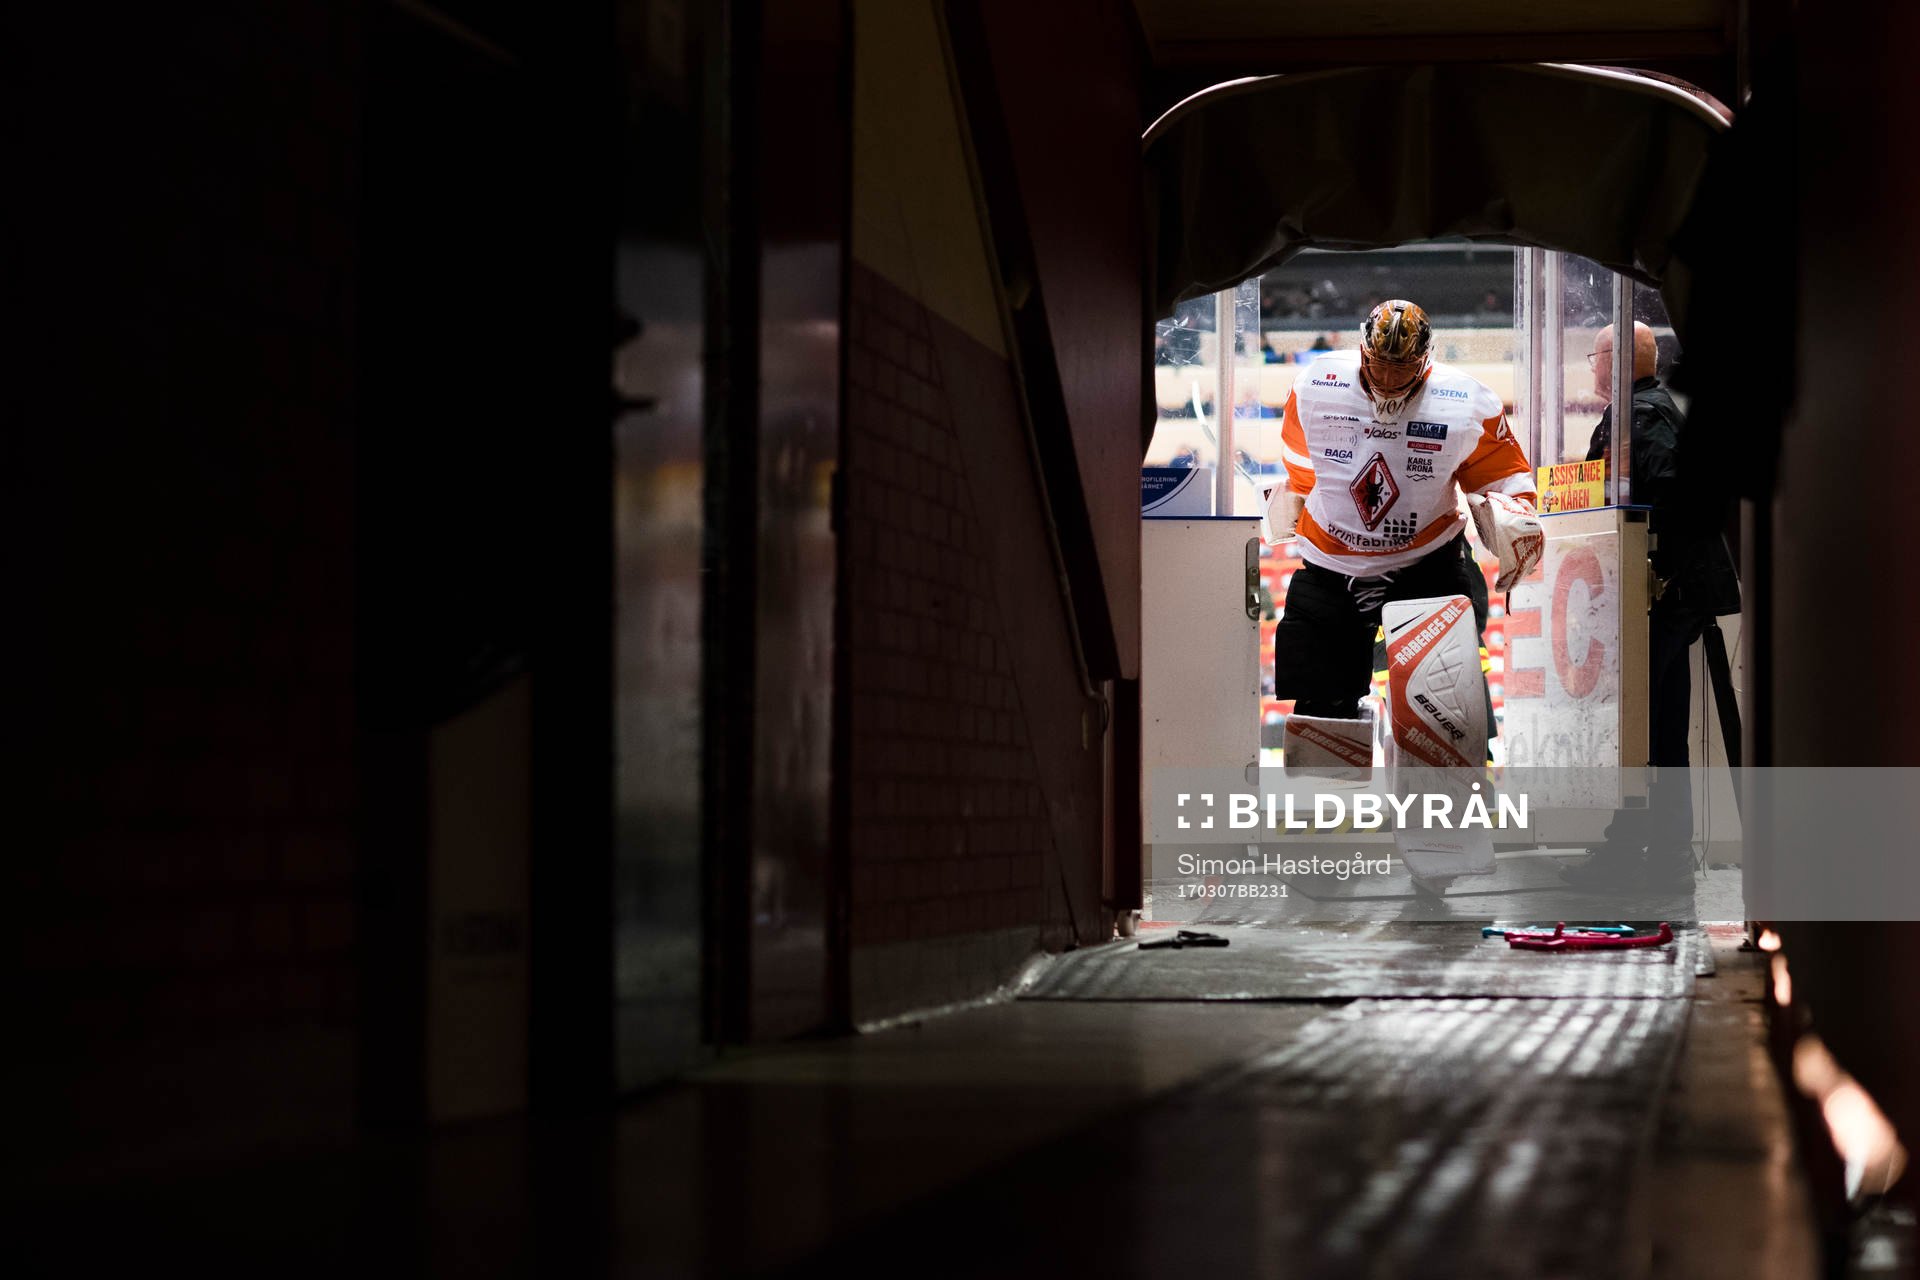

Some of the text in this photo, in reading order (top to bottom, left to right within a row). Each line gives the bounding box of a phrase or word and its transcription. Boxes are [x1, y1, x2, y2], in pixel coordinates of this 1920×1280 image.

[1439, 388, 1469, 399] STENA
[1325, 448, 1353, 459] BAGA
[1406, 464, 1434, 474] KRONA
[1408, 457, 1433, 466] KARLS
[1549, 461, 1601, 487] ASSISTANCE
[1560, 487, 1590, 511] KÅREN
[1440, 605, 1463, 624] BIL
[1414, 694, 1465, 740] BAUER
